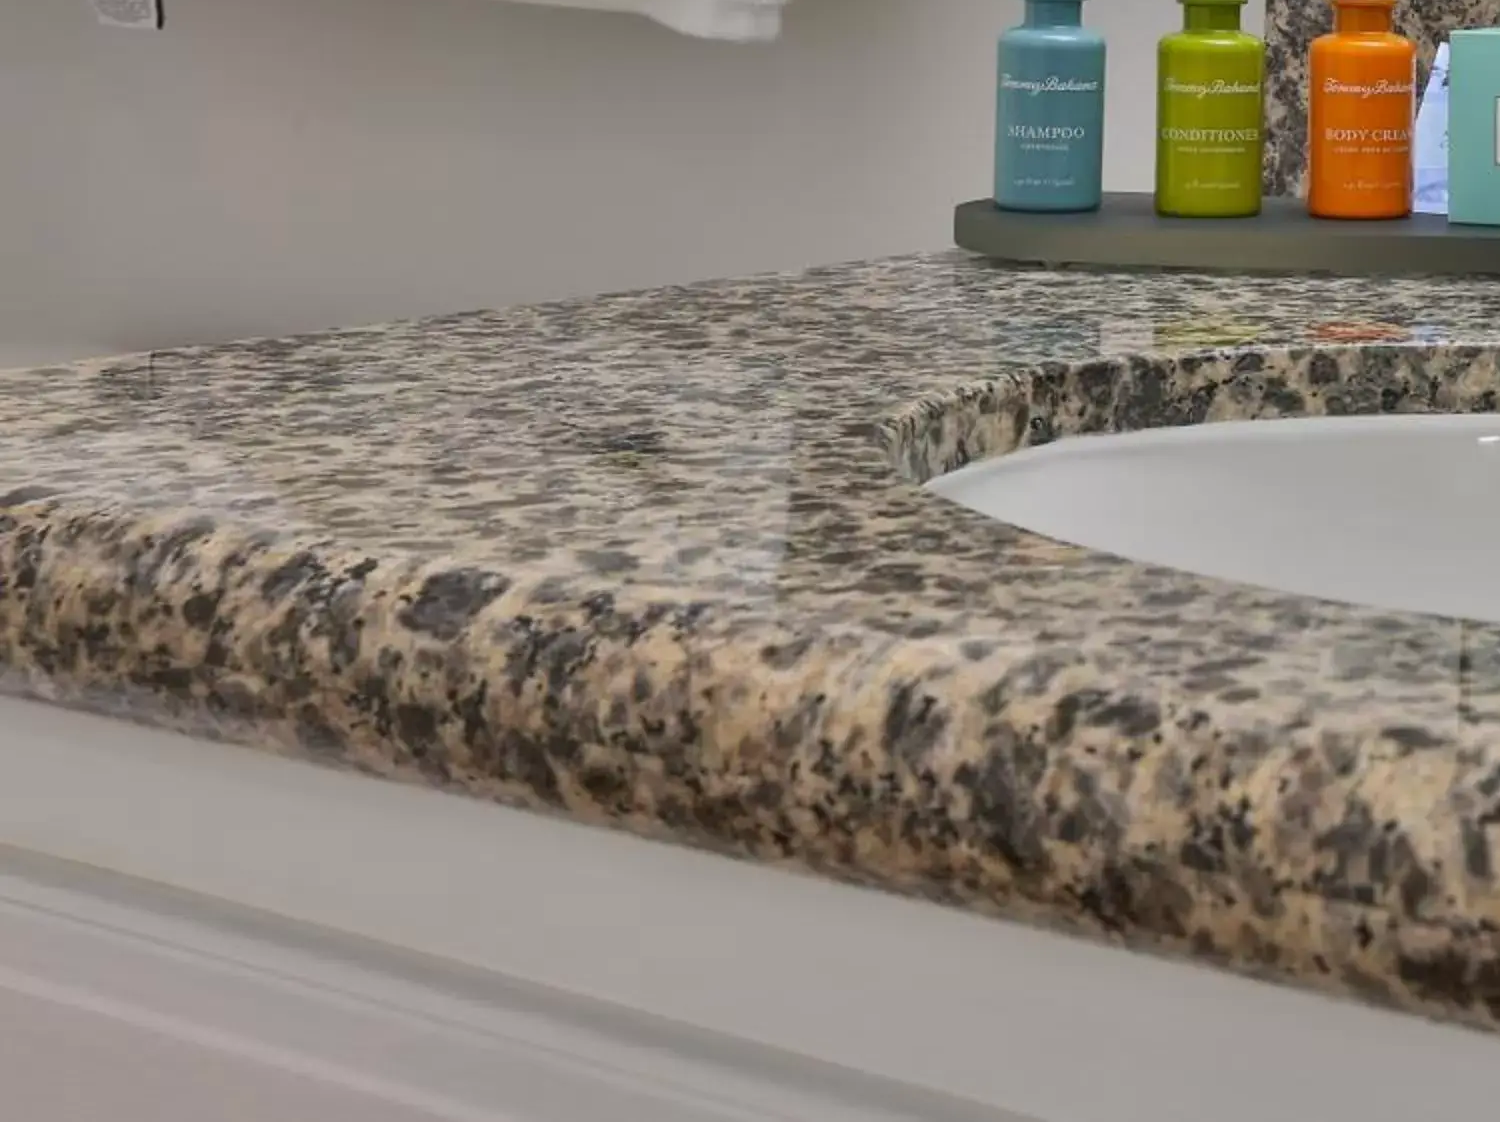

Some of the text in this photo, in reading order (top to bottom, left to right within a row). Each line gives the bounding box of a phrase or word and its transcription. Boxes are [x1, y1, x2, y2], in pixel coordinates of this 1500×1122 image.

[1001, 73, 1099, 96] Tommy Bahama
[1163, 77, 1208, 99] Tommy
[1324, 77, 1415, 98] Tommy Baham
[1007, 125, 1085, 139] SHAMPOO
[1325, 127, 1414, 142] BODY CREA
